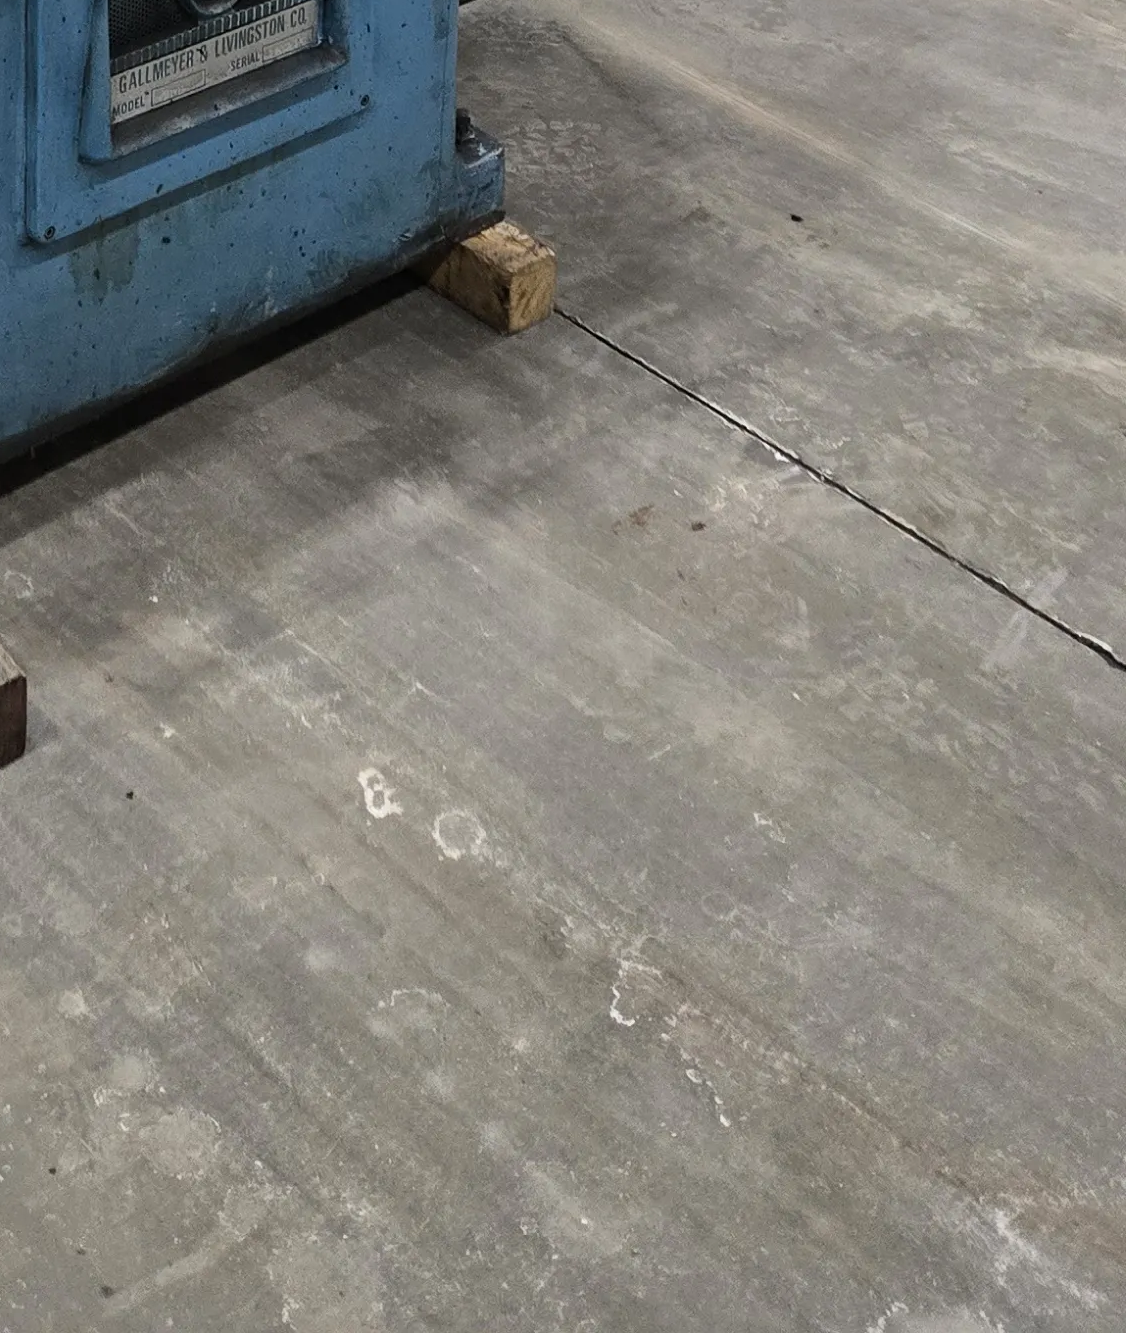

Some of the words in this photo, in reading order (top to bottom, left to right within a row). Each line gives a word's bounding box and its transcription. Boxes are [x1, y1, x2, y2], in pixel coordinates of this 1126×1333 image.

[112, 95, 146, 117] MODEL
[230, 52, 261, 72] SERIAL
[118, 48, 194, 94] GALLMEYER
[214, 14, 285, 58] LIVINGSTON
